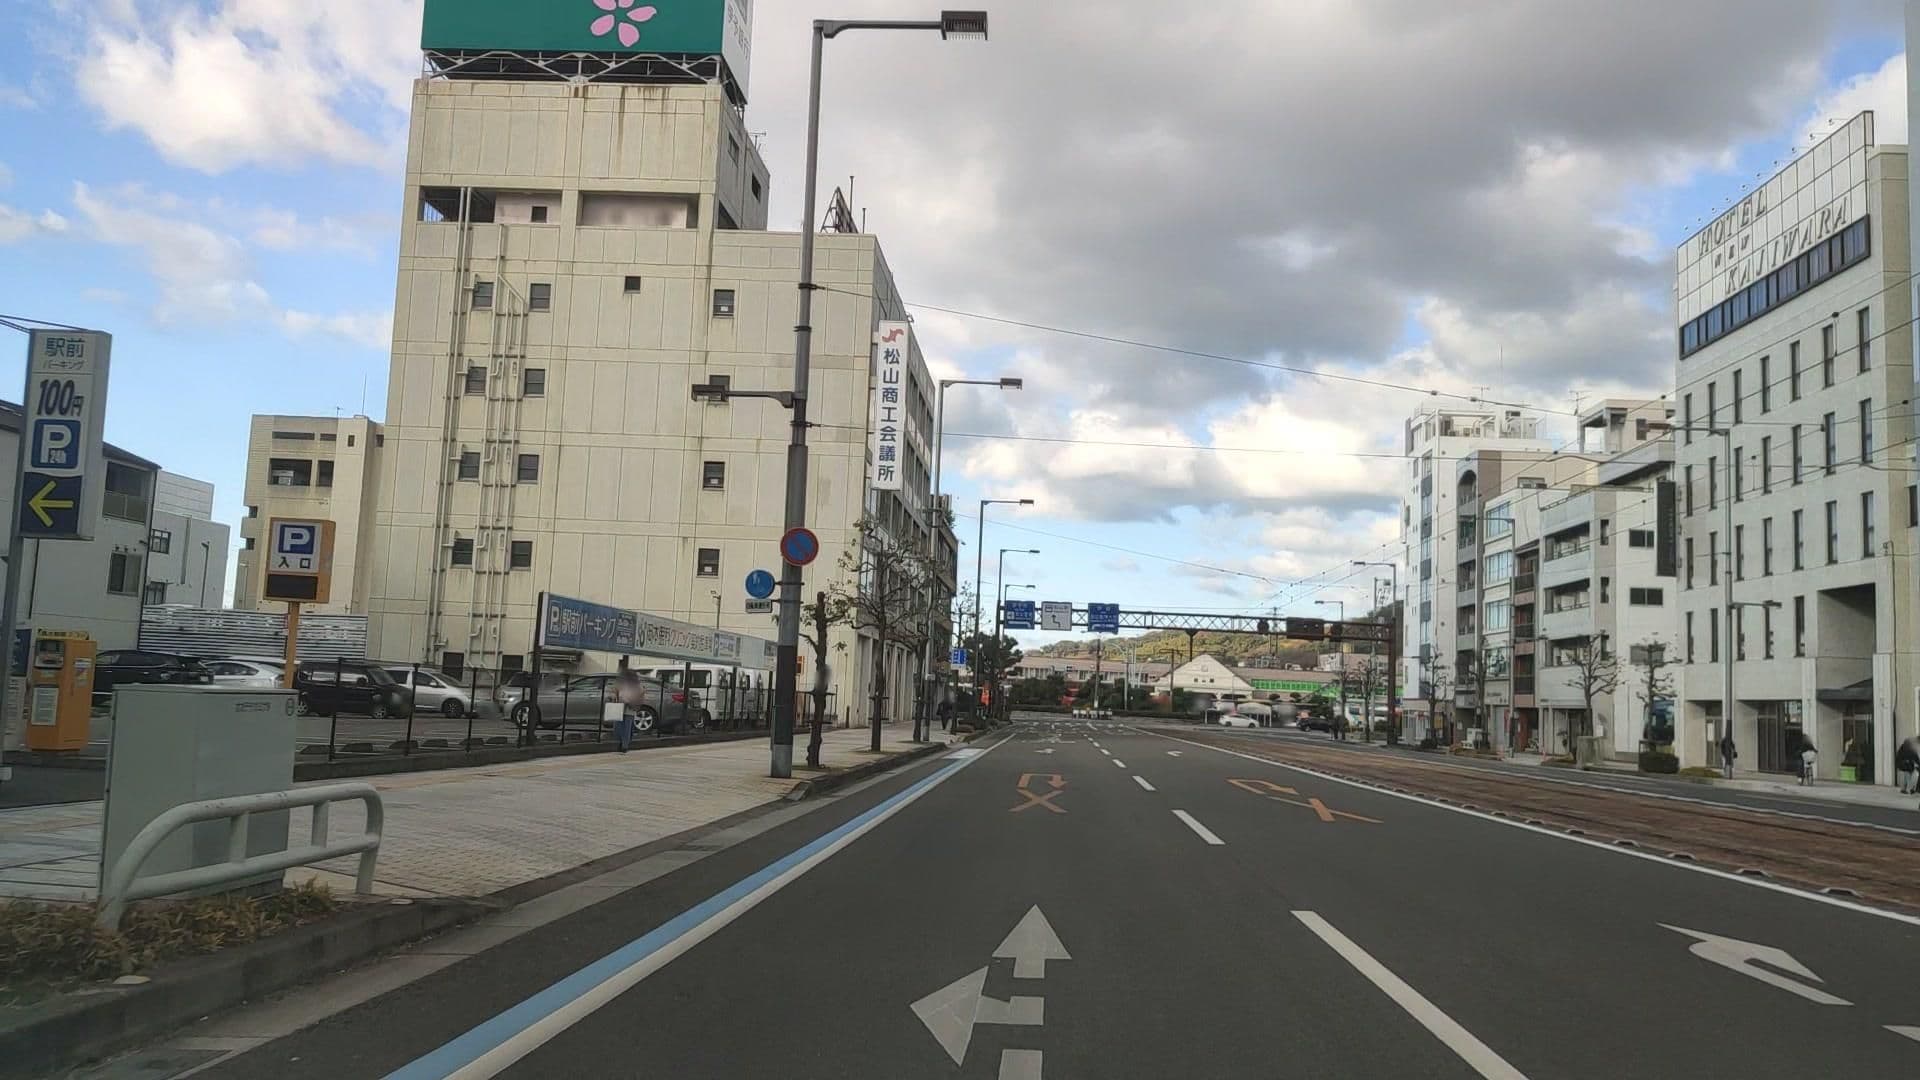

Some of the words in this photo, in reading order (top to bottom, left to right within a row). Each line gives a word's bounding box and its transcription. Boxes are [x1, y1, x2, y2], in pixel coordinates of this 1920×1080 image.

[1699, 189, 1767, 257] HOTEL
[1726, 197, 1848, 295] KAJIWARA
[45, 337, 85, 358] 駅前
[37, 379, 85, 417] 100円
[878, 348, 900, 482] 松山商工会議所
[278, 556, 311, 569] 入口
[561, 607, 617, 639] 駅前パーキング
